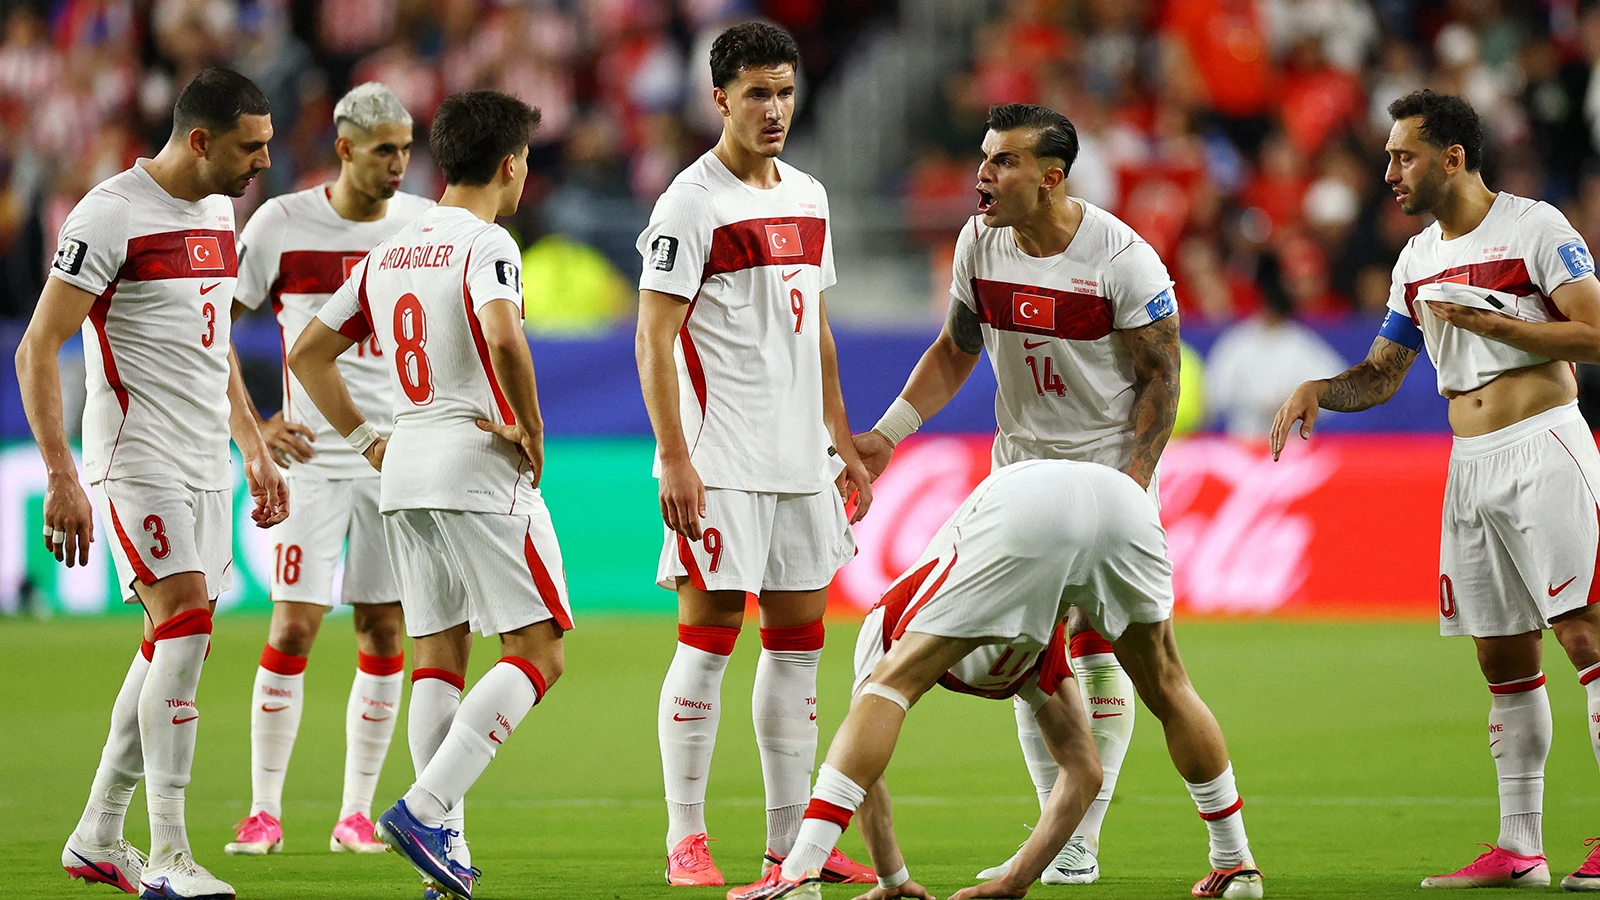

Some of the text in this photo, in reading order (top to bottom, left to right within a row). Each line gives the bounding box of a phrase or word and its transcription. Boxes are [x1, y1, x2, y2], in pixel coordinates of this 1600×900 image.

[202, 302, 216, 349] 3
[790, 288, 805, 335] 9
[393, 292, 434, 406] 8
[1025, 355, 1067, 397] 14
[143, 514, 171, 560] 3
[702, 527, 723, 573] 9
[275, 543, 303, 585] 18
[673, 696, 712, 711] TÜRKİYE
[1089, 696, 1125, 706] TÜRKİYE
